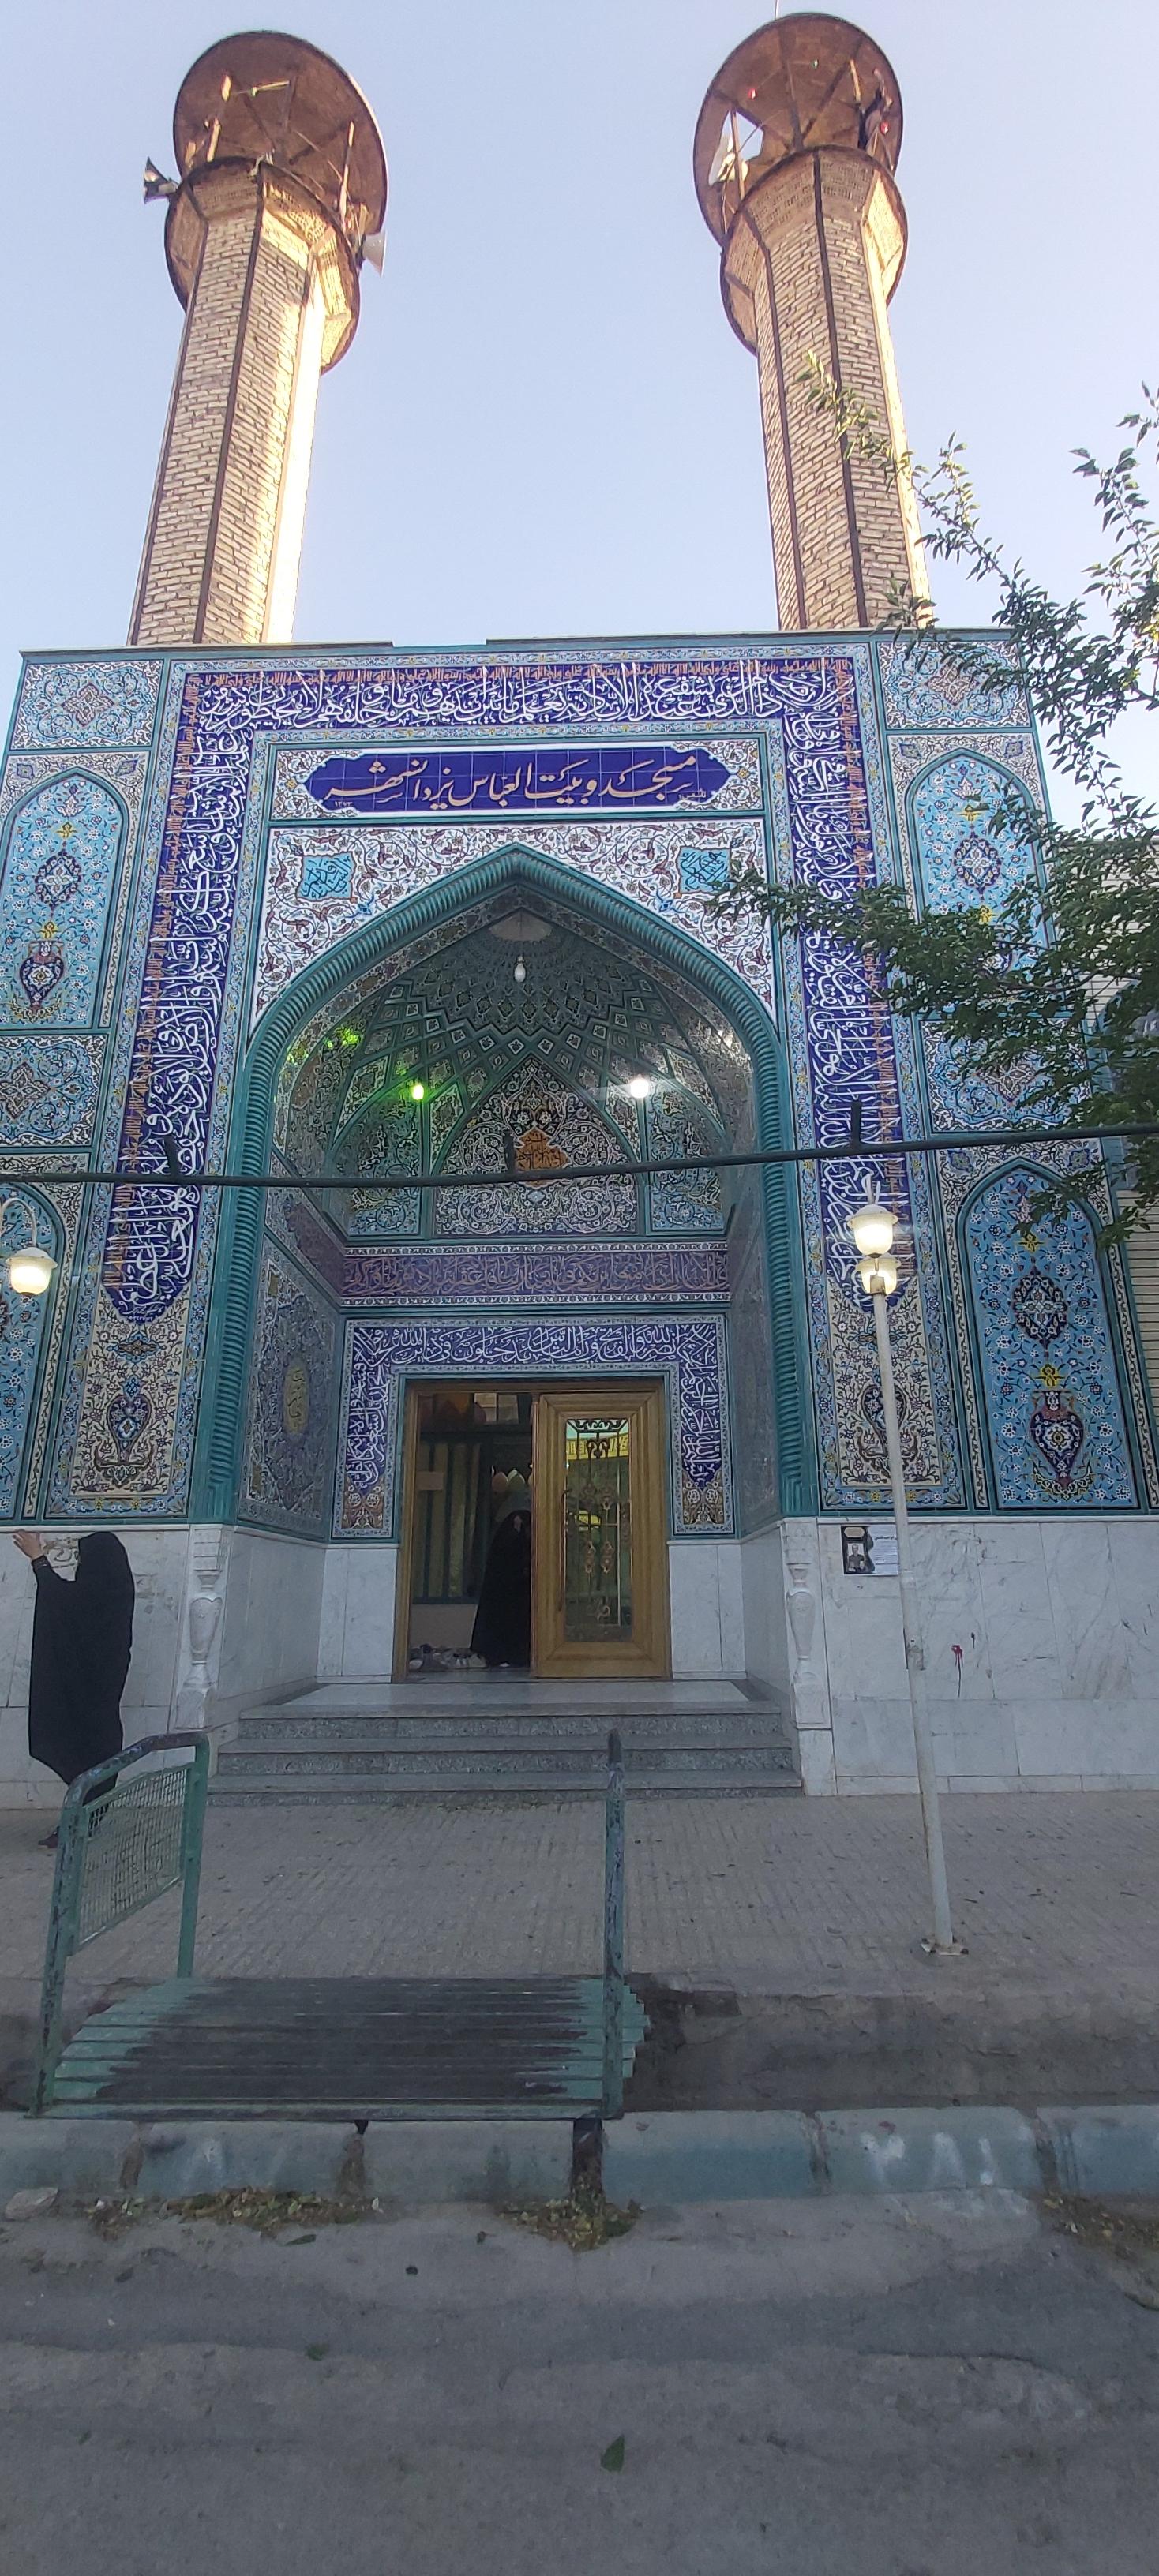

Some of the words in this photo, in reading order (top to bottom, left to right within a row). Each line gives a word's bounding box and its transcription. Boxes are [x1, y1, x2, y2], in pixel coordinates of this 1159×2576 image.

[323, 758, 455, 810] یزدانشهر
[448, 762, 534, 808] العباس
[524, 758, 590, 805] بیت
[598, 754, 696, 800] مسجد
